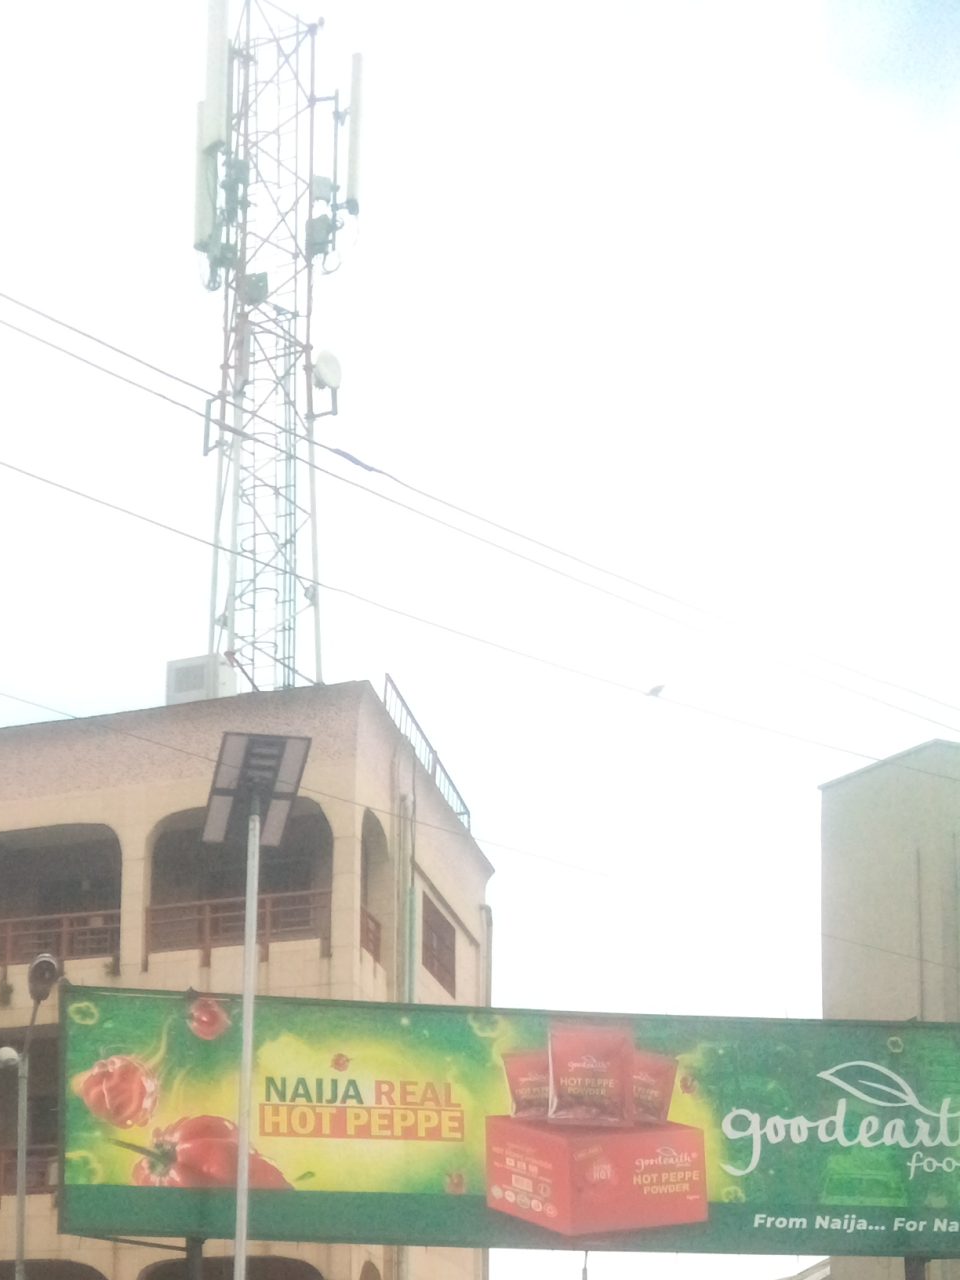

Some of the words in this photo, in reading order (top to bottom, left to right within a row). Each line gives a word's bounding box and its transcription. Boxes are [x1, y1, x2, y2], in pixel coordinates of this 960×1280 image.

[265, 1076, 364, 1105] NAIJA
[375, 1080, 461, 1108] REAL
[264, 1105, 337, 1135] HOT
[346, 1108, 462, 1138] PEPPE
[720, 1097, 960, 1177] goodeart
[633, 1173, 658, 1185] HOT
[661, 1170, 700, 1183] PEPPE
[907, 1151, 960, 1180] foo
[643, 1183, 690, 1195] POWDER
[753, 1214, 807, 1229] From
[815, 1214, 886, 1233] Naija...
[893, 1218, 927, 1232] For
[934, 1219, 960, 1233] Na
